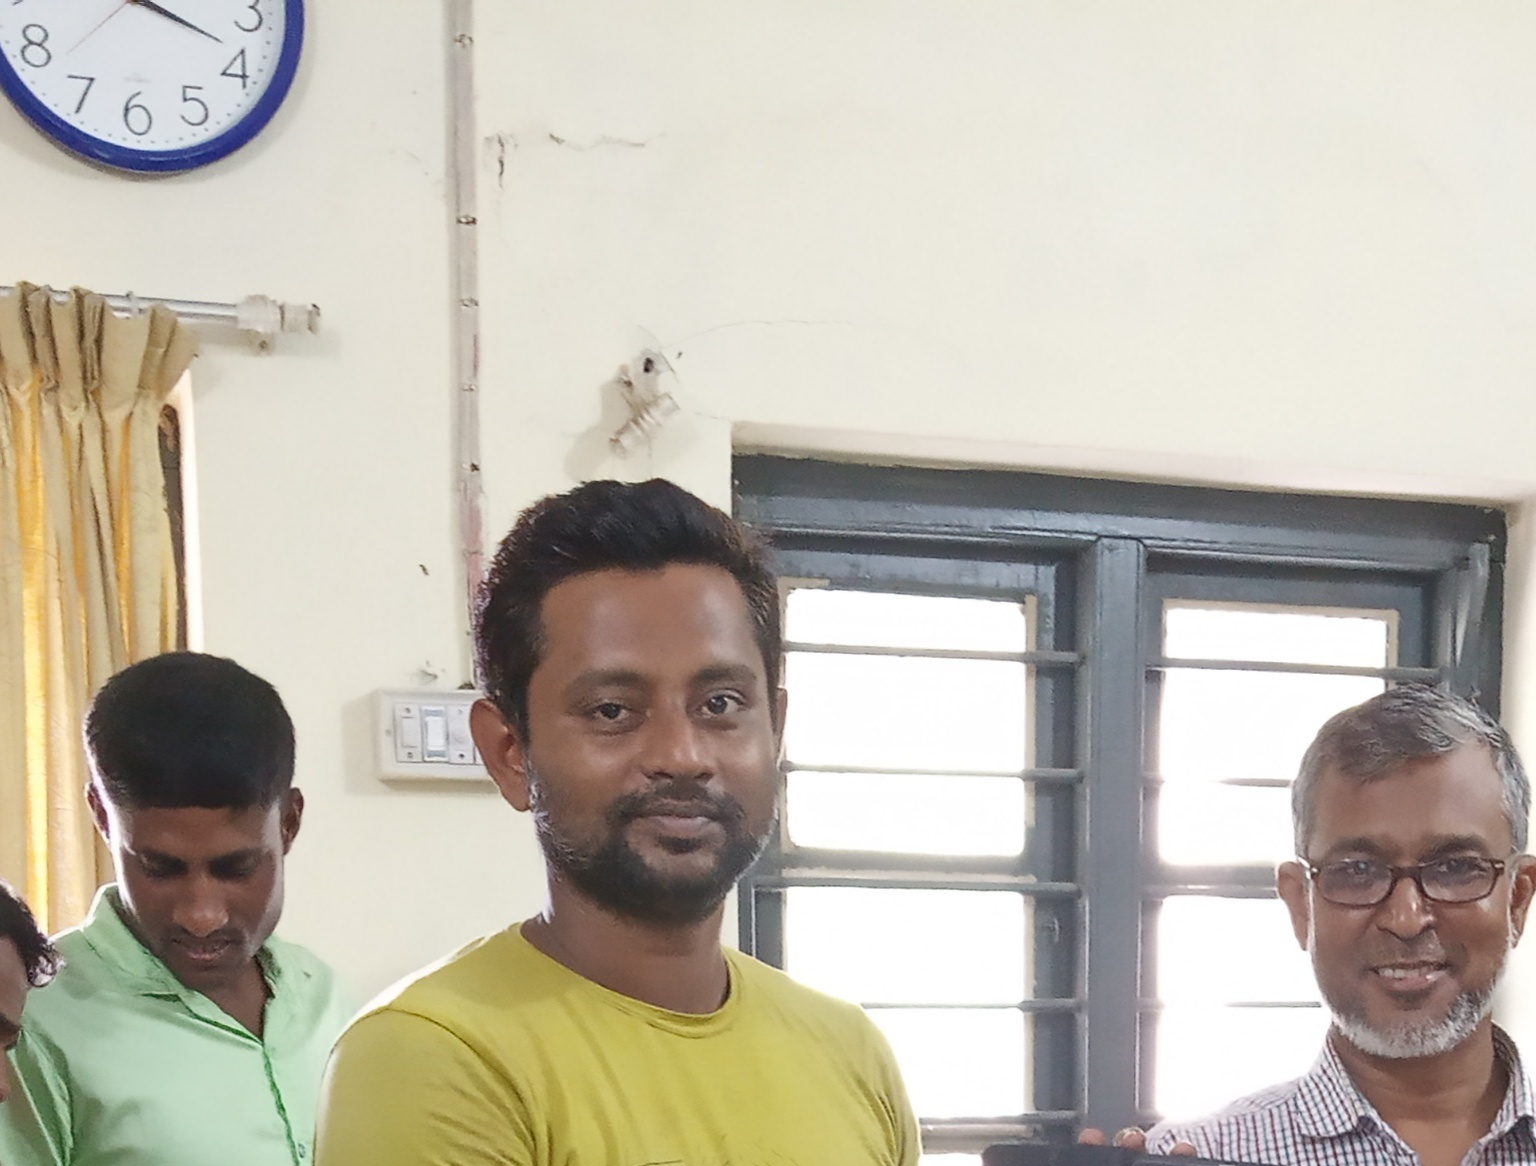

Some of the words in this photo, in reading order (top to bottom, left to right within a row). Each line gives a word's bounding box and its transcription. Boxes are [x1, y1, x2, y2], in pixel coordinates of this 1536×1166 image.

[233, 0, 263, 32] 3
[20, 23, 52, 68] 8
[219, 47, 250, 90] 4
[66, 74, 96, 114] 7
[123, 90, 153, 136] 6
[180, 85, 209, 127] 5
